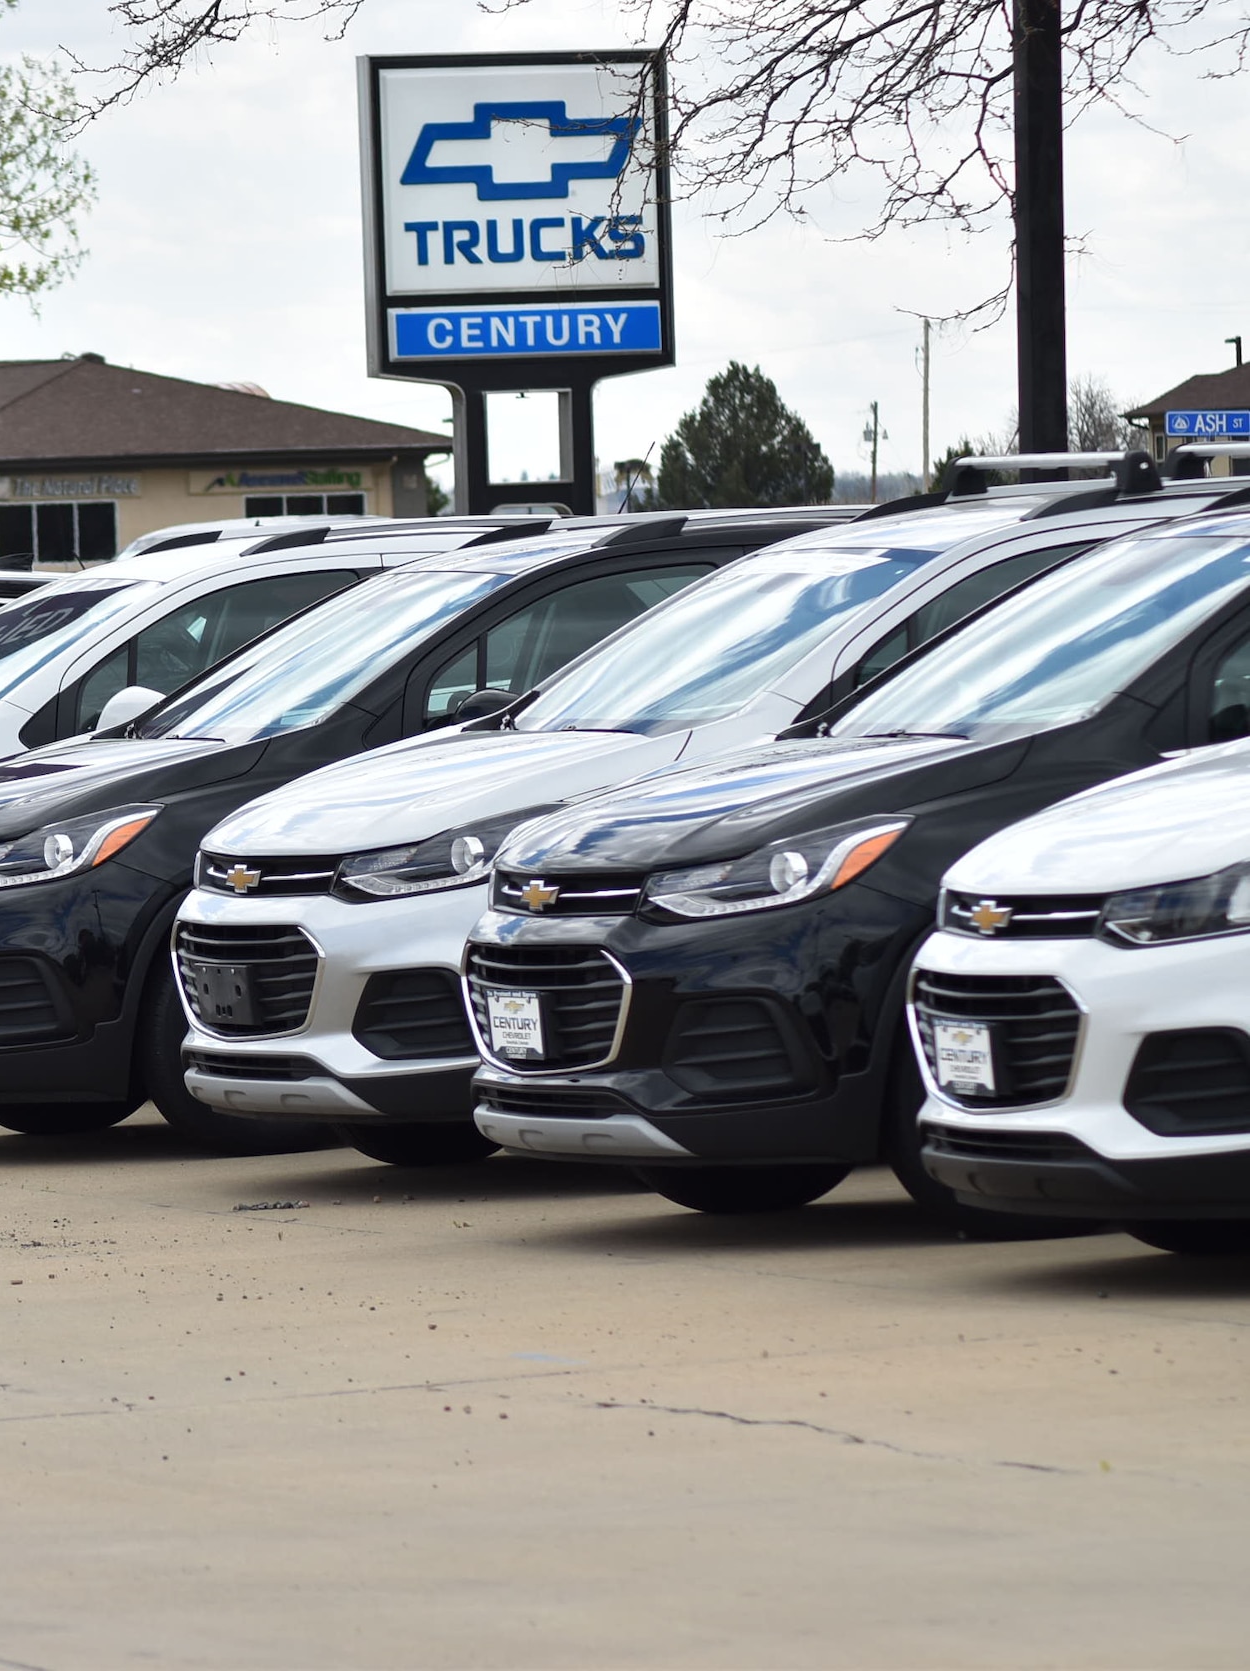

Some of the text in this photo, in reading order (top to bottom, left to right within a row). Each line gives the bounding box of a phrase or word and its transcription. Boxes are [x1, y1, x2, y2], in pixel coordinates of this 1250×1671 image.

[404, 215, 646, 266] TRUCKS
[426, 313, 628, 350] CENTURY
[1194, 414, 1244, 433] ASH ST
[15, 478, 40, 497] The
[41, 476, 98, 496] Natural
[493, 1016, 538, 1031] CENTURY
[502, 1032, 532, 1040] CHEVROLET
[941, 1048, 989, 1065] CENTURY
